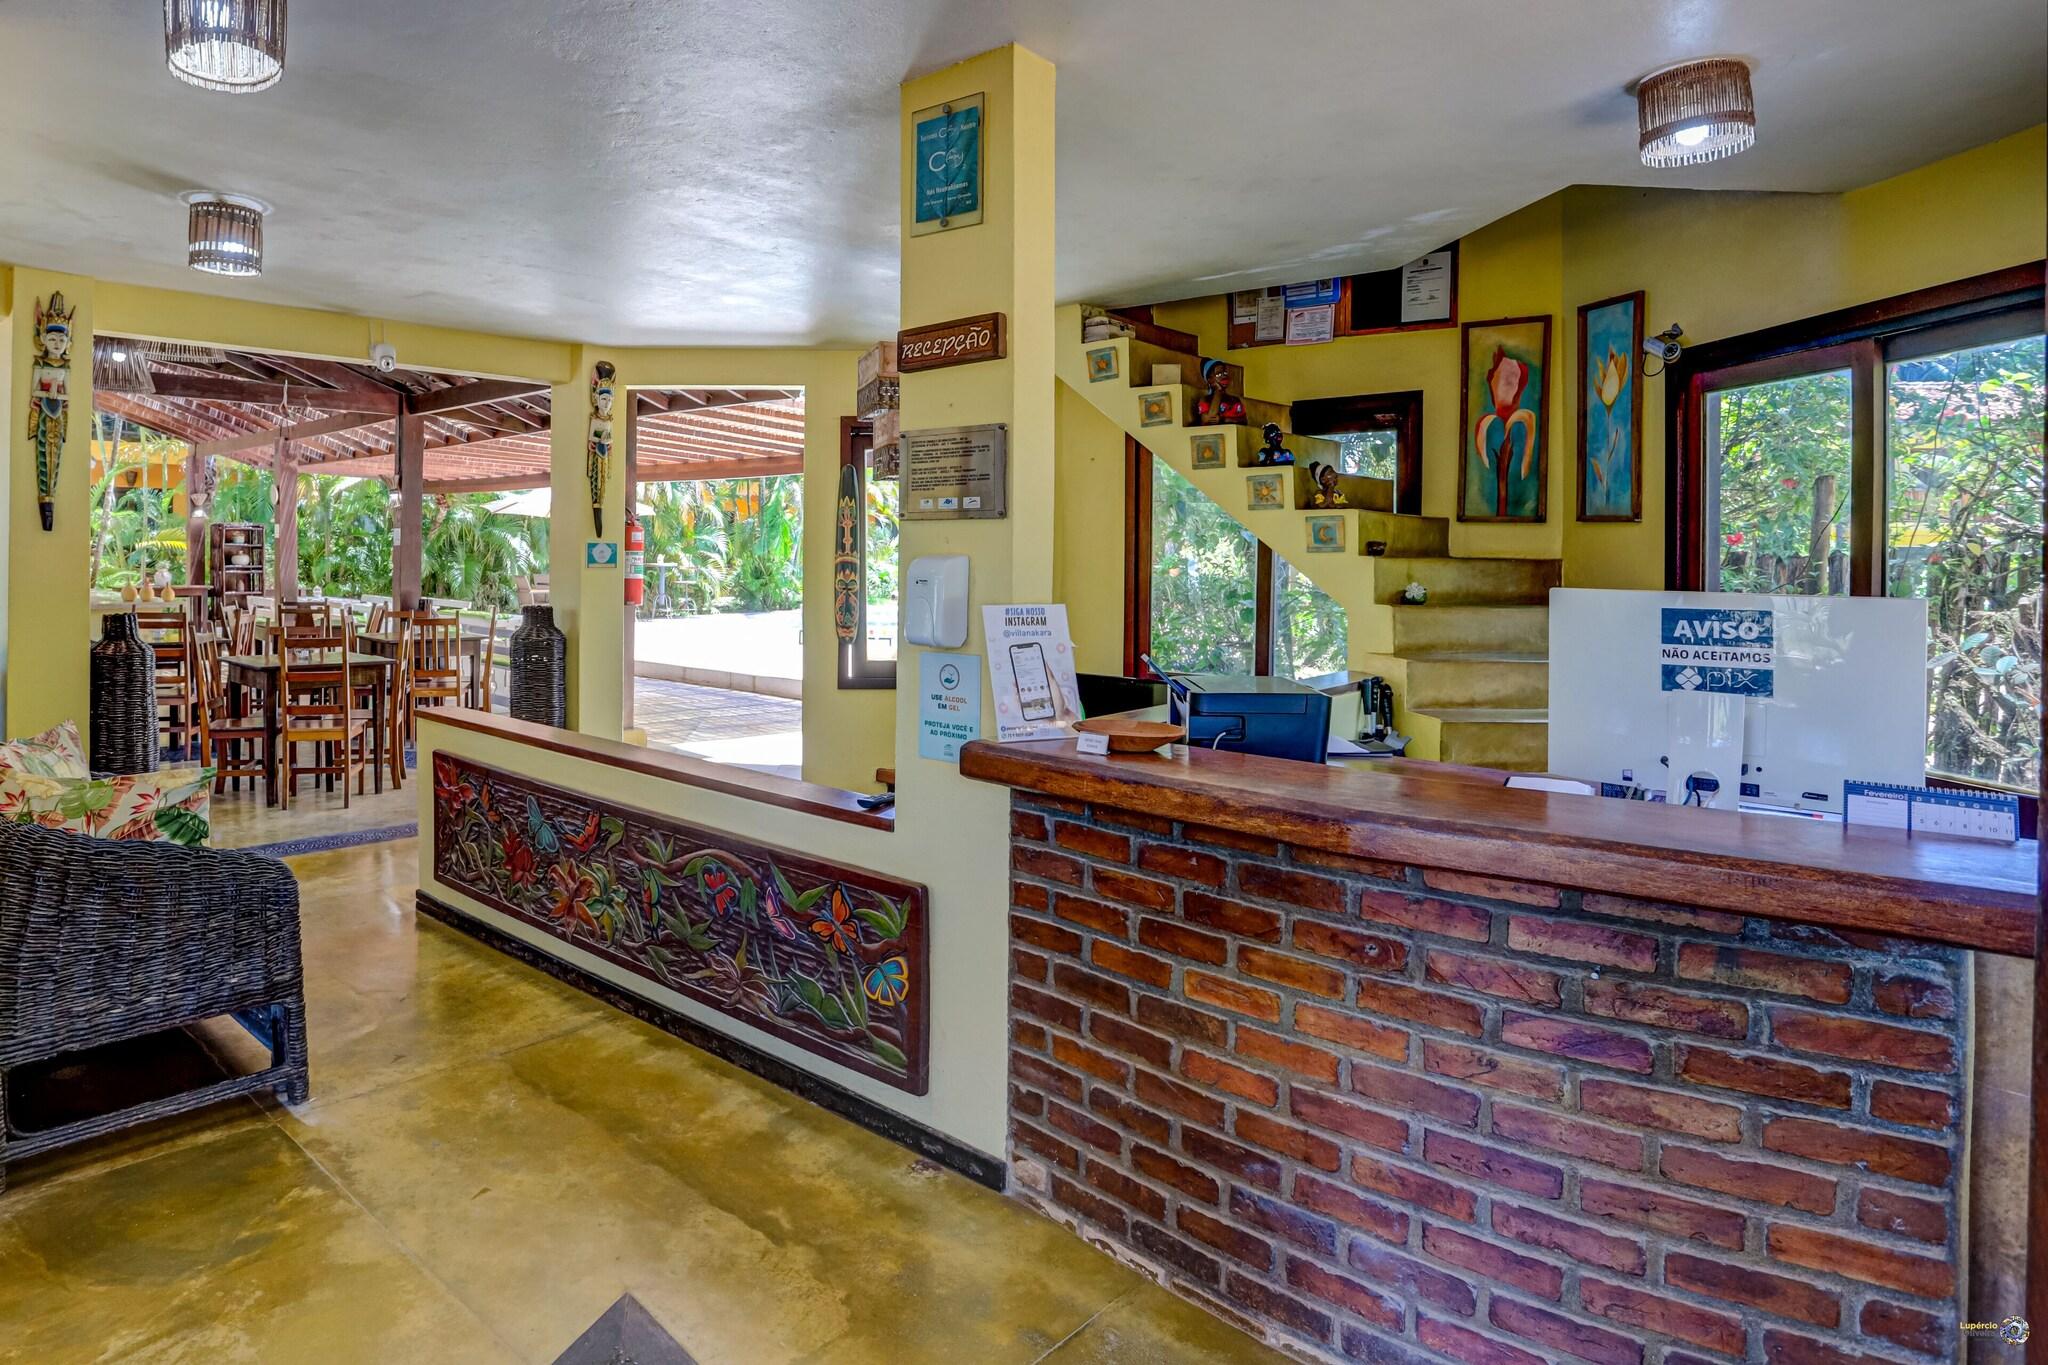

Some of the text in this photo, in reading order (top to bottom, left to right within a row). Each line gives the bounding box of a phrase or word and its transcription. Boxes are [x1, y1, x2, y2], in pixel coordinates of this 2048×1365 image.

[901, 326, 990, 359] RECEPÇÃO
[1026, 607, 1046, 616] NOSSO
[1004, 616, 1047, 626] INSTAGRAM
[1003, 629, 1052, 638] @villanakara
[1673, 619, 1760, 640] AVISO
[1662, 648, 1689, 660] NÃO
[931, 693, 943, 701] USE
[924, 720, 950, 729] PROTEJA
[1864, 789, 1904, 800] Fevereiro
